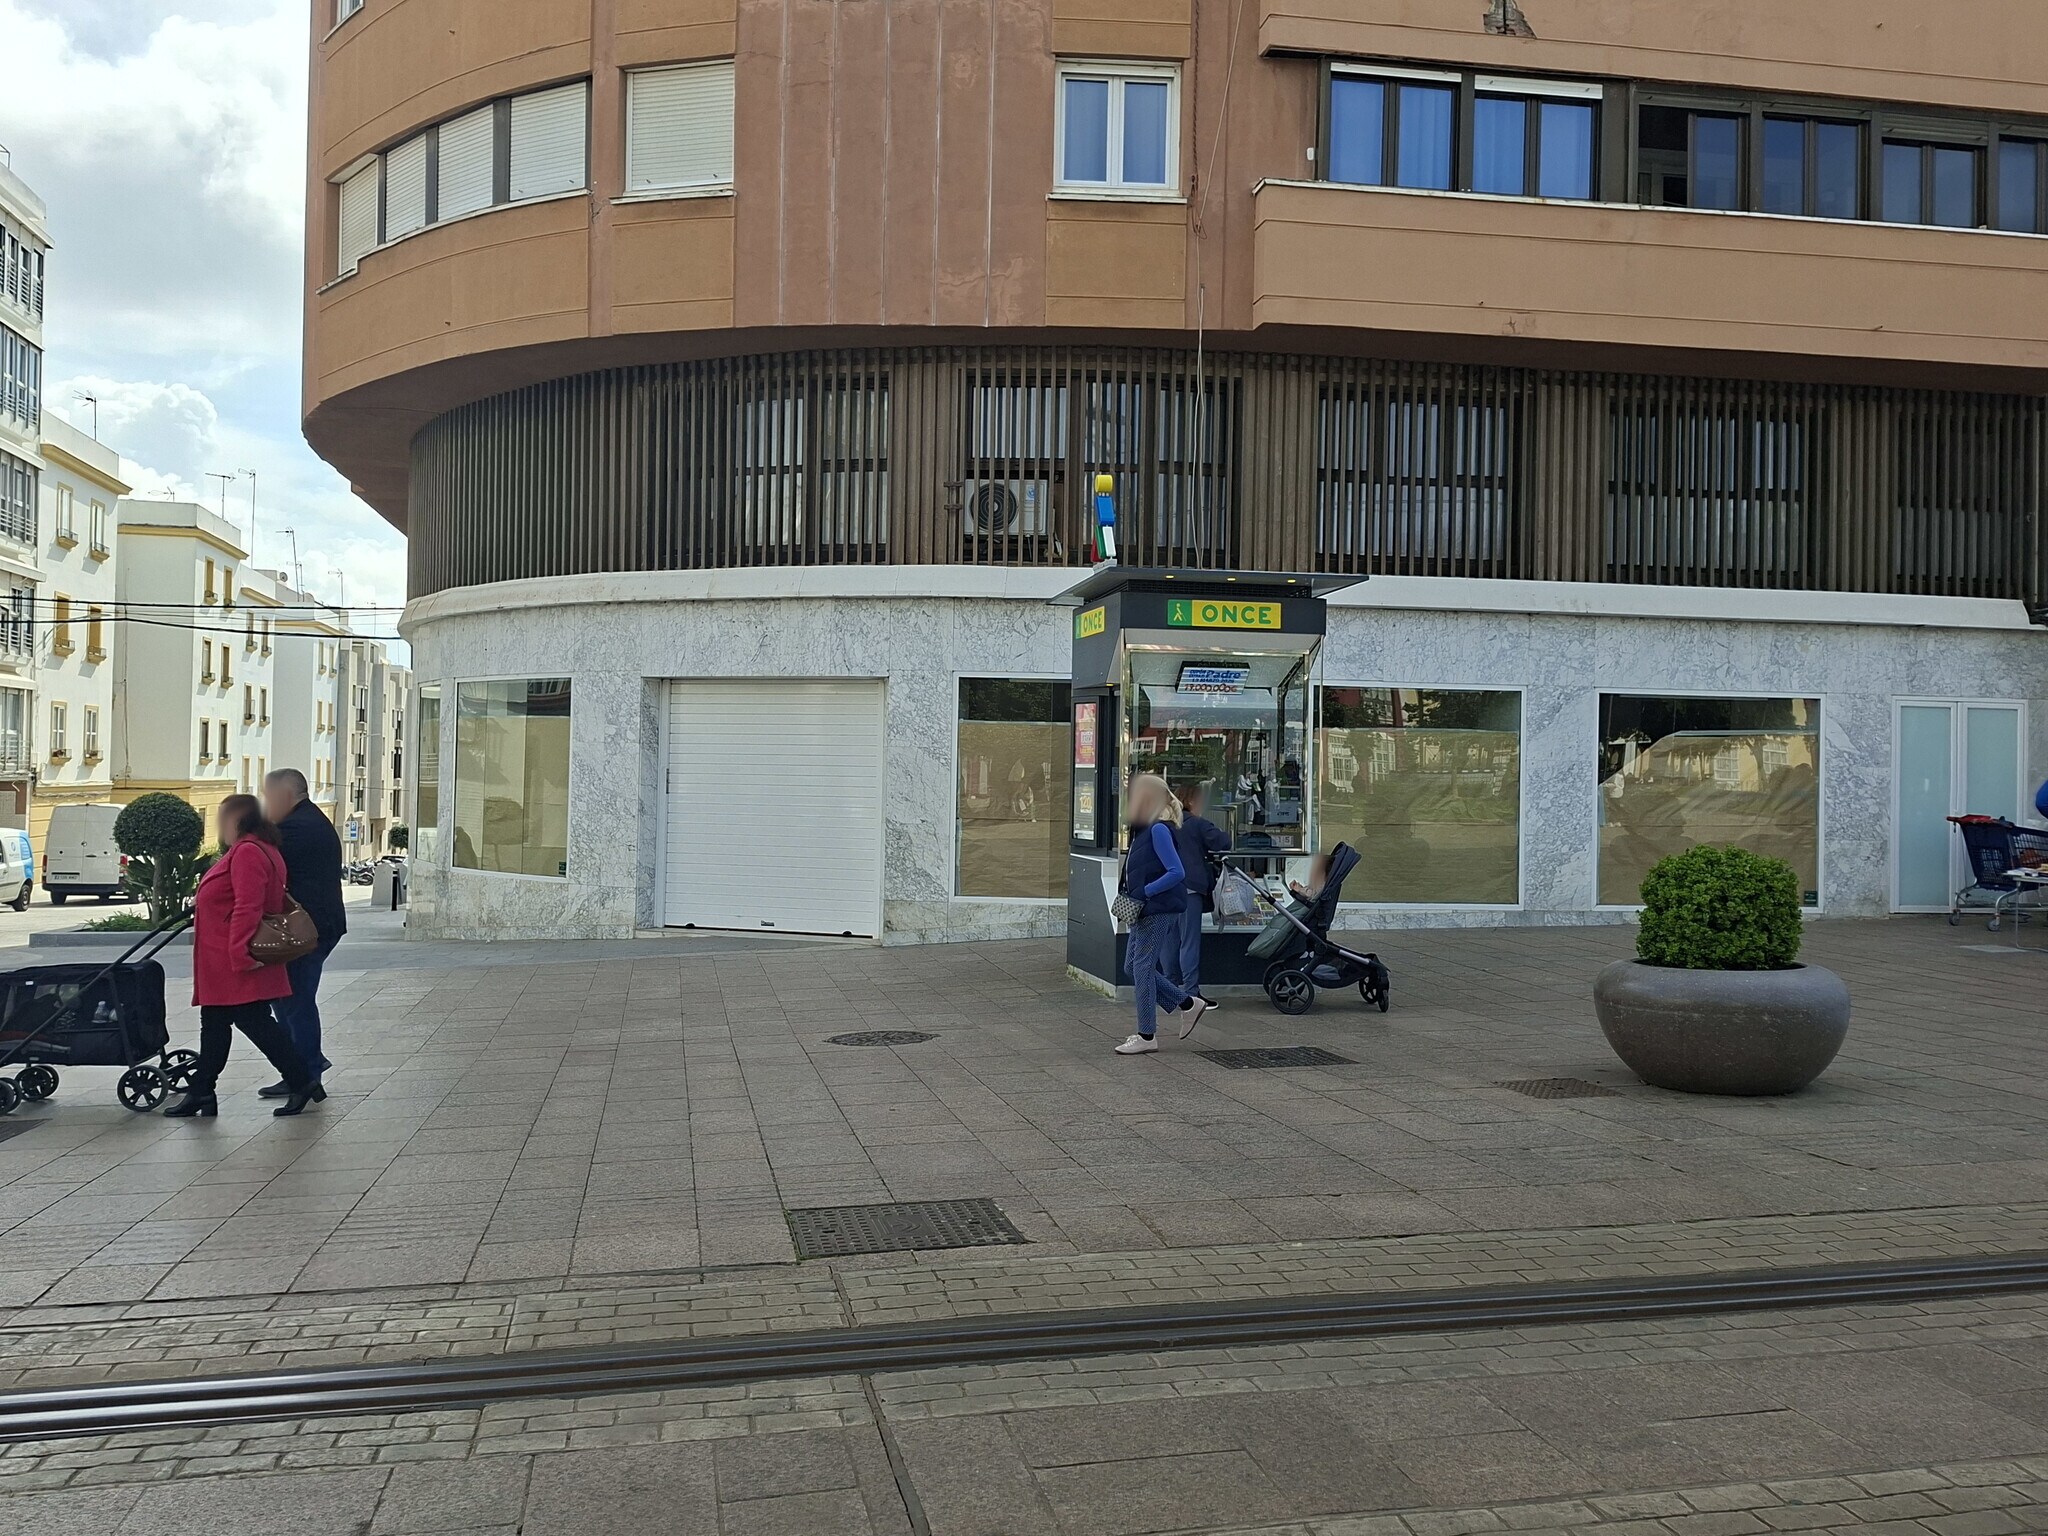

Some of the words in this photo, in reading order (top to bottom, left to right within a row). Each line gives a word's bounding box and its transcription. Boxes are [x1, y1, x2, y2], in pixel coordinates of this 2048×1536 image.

[1083, 610, 1102, 632] ONCE
[1201, 604, 1272, 625] ONCE
[1206, 670, 1240, 679] Padre
